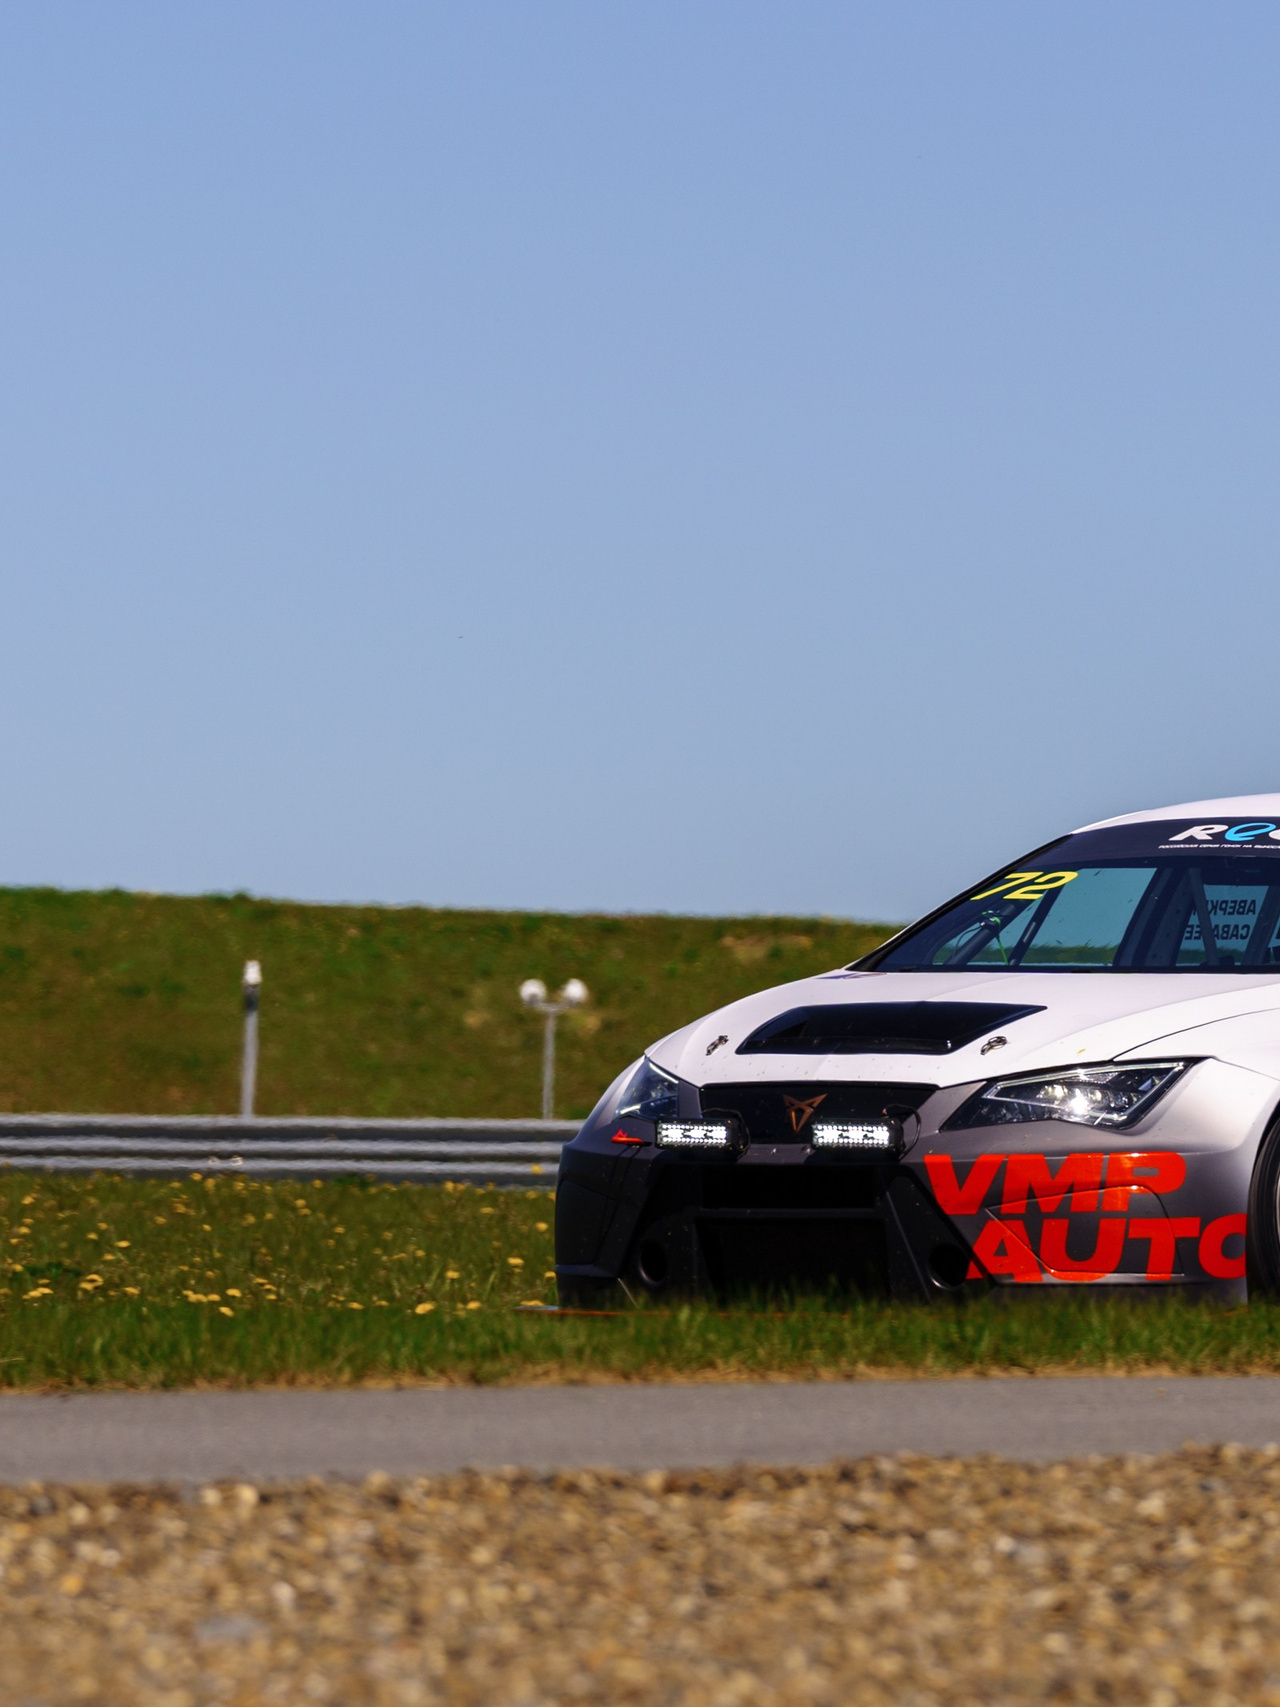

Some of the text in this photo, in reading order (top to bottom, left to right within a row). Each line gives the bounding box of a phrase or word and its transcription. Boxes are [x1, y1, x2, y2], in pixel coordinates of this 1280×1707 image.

[970, 871, 1078, 900] 72
[923, 1151, 1187, 1216] VMP
[966, 1213, 1248, 1283] AUTO
